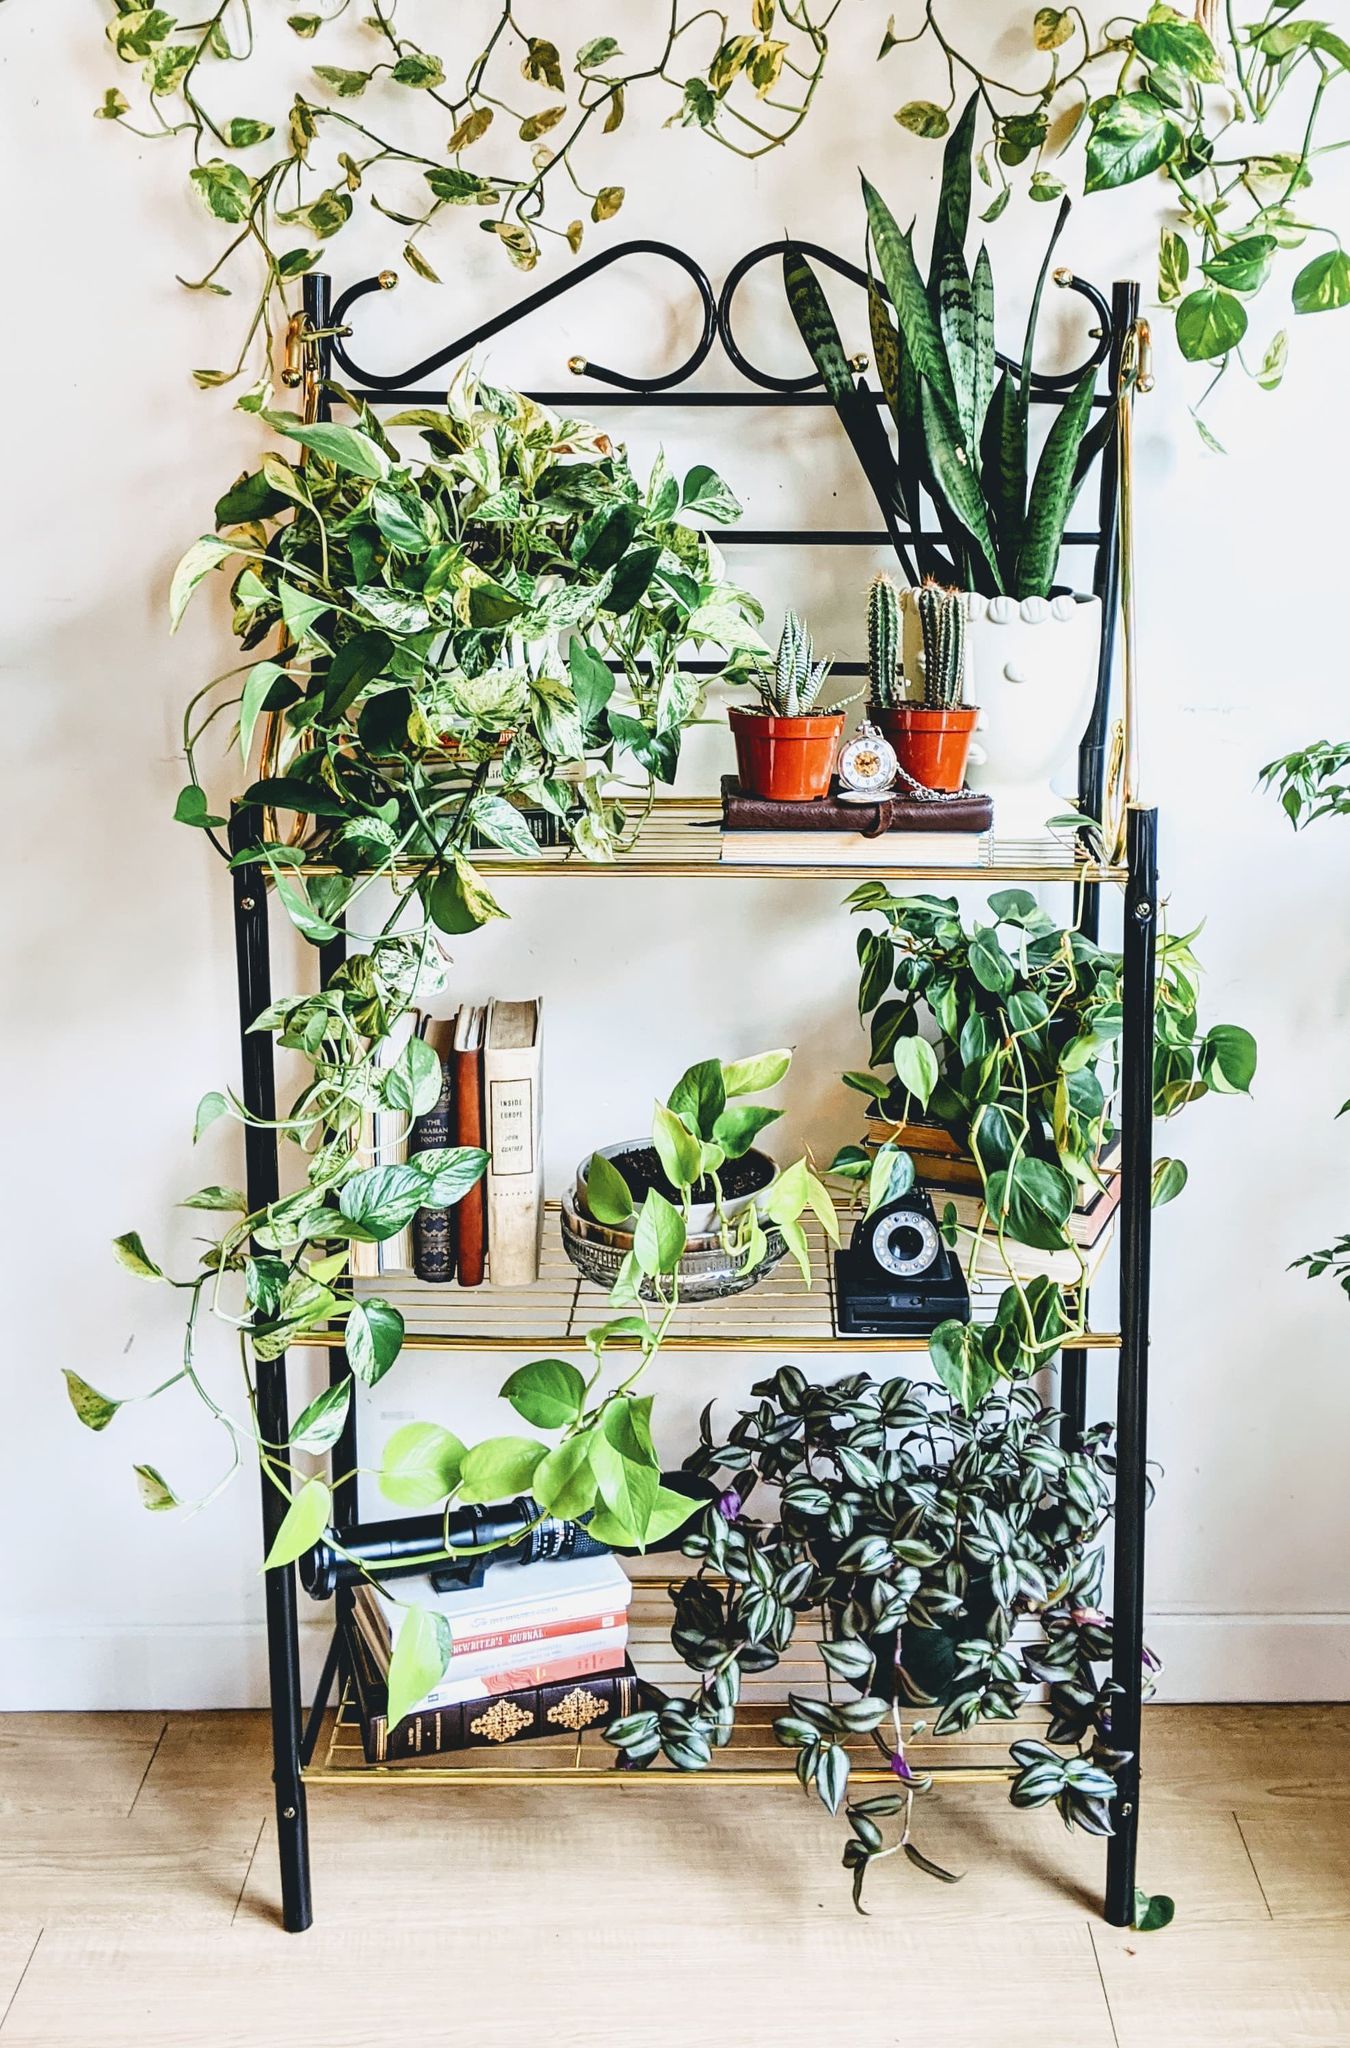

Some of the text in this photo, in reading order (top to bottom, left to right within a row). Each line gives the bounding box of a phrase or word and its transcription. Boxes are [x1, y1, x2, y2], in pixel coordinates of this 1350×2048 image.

[427, 1118, 441, 1126] THE
[418, 1126, 448, 1135] ARABIAN
[420, 1135, 447, 1144] NIGHTS
[508, 1629, 544, 1644] JOURNAL
